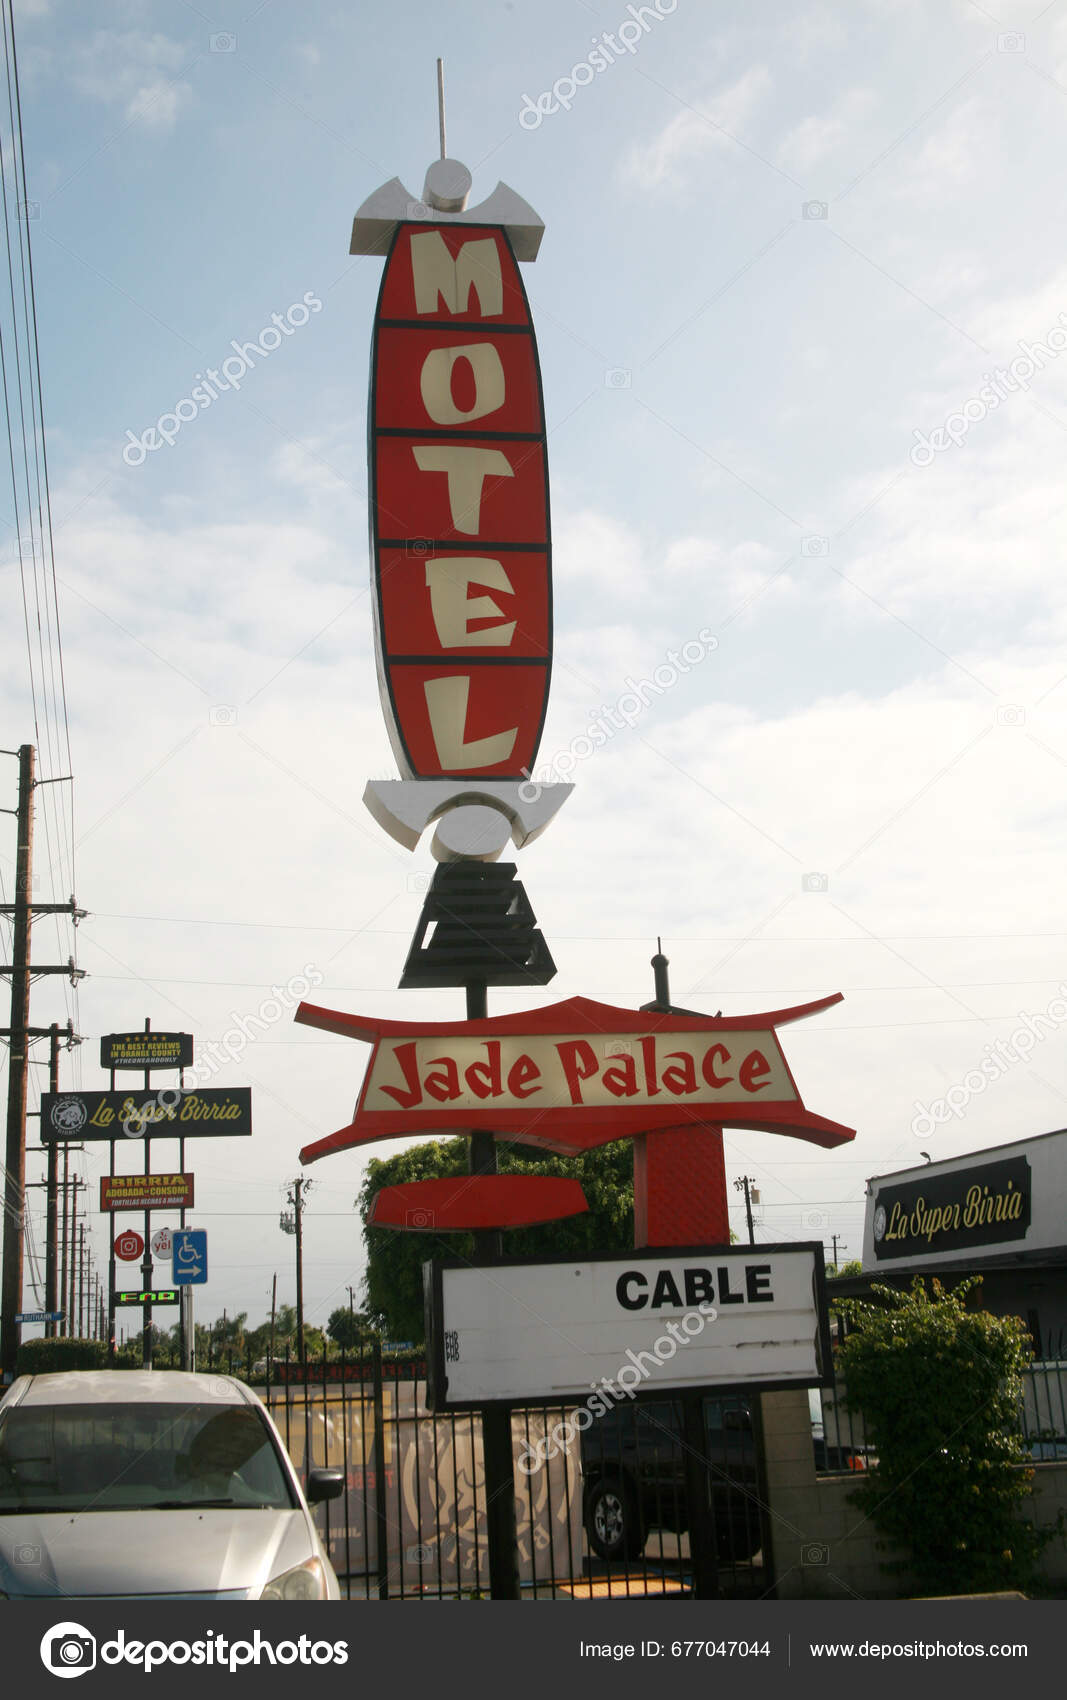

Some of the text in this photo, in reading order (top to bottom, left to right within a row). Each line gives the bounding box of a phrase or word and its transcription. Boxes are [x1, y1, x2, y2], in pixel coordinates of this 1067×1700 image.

[410, 230, 518, 770] MOTEL
[379, 1035, 773, 1110] Jade Palace
[89, 1098, 116, 1128] La
[180, 1095, 242, 1122] Birria
[105, 1187, 145, 1198] ADOBADA
[111, 1175, 186, 1188] BIRRIA
[884, 1180, 1023, 1243] La Super Birria
[154, 1240, 171, 1252] yel
[615, 1264, 774, 1311] CABLE
